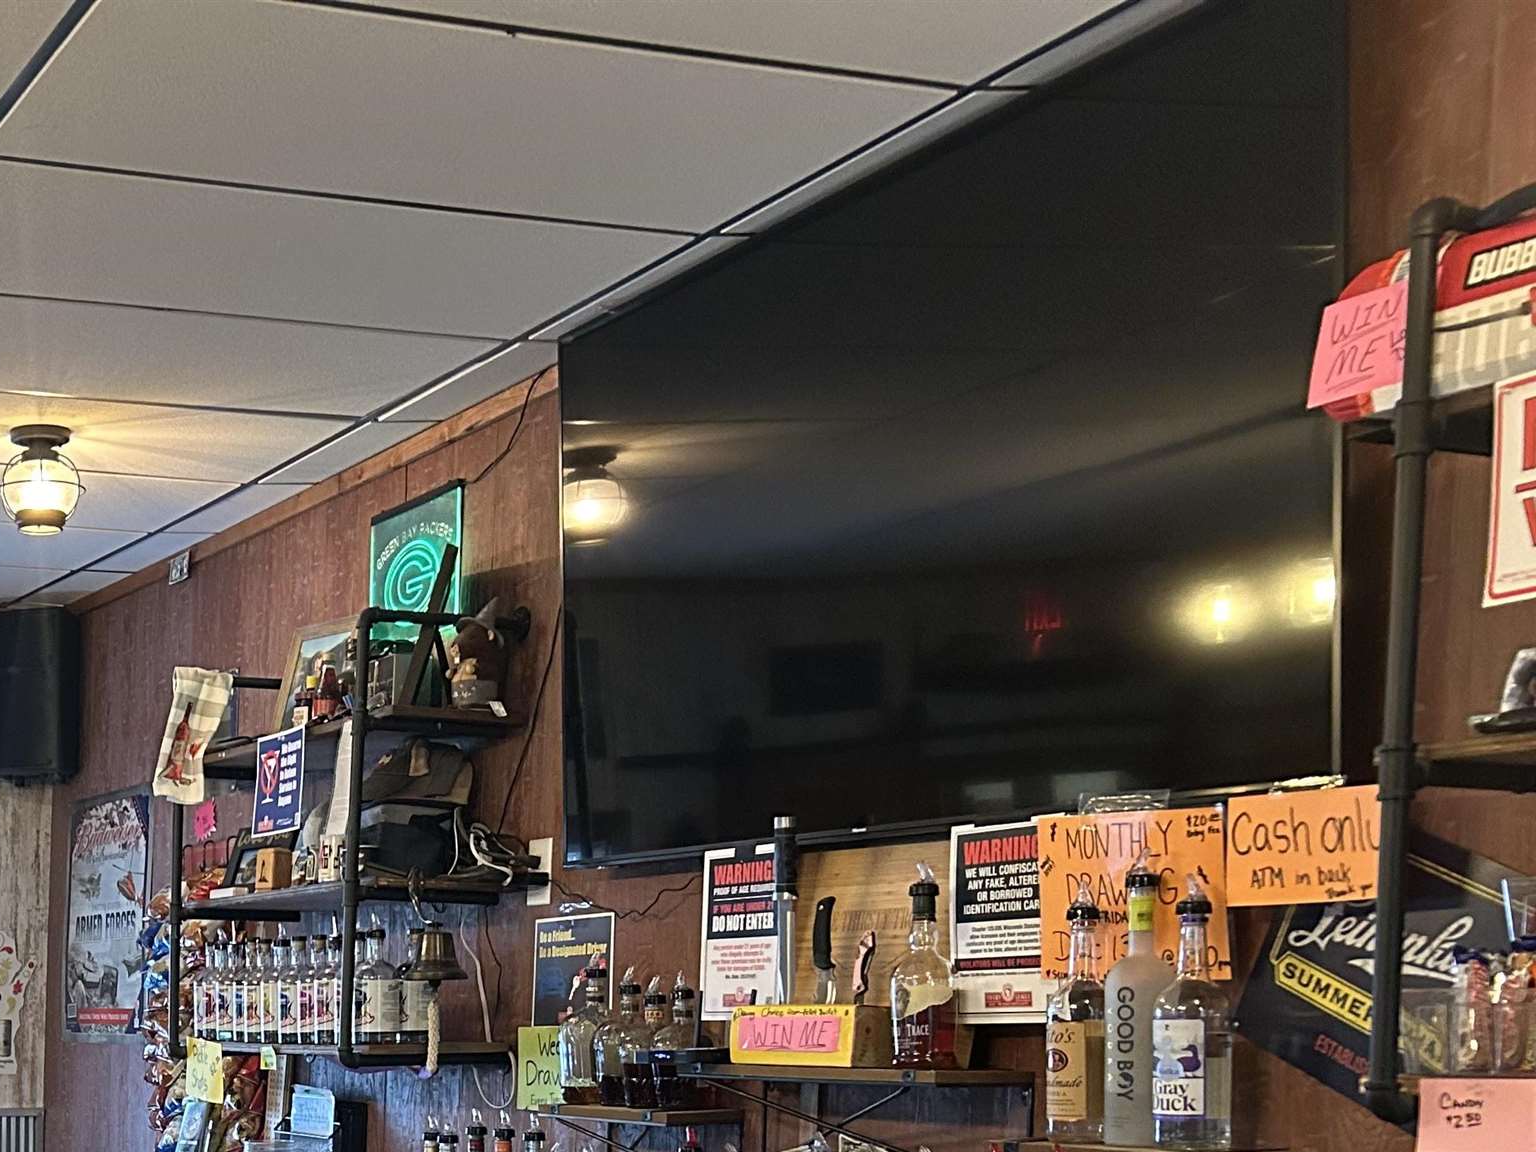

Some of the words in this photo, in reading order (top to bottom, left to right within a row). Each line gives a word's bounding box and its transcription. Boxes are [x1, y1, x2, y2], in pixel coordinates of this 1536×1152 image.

[75, 820, 145, 852] Budweiser
[1066, 820, 1174, 860] MONTHLY
[1231, 805, 1313, 857] Cash
[965, 868, 978, 879] WE
[978, 866, 997, 878] WILL
[967, 879, 984, 891] ANY
[984, 877, 1007, 890] FAKE,
[1250, 865, 1285, 890] ATM
[1295, 872, 1311, 886] in
[1316, 862, 1352, 886] back
[713, 885, 730, 896] PROOF
[739, 885, 750, 894] AGE
[976, 892, 988, 902] OR
[990, 887, 1034, 900] BORROWED
[712, 915, 725, 933] DO
[725, 913, 744, 931] NOT
[745, 911, 775, 931] ENTER
[963, 900, 1022, 916] IDENTIFICATION
[75, 914, 103, 939] ARMED
[105, 909, 137, 938] FORCES
[1281, 962, 1375, 1022] SUMME
[752, 1019, 795, 1047] WIN
[800, 1020, 833, 1048] ME
[1117, 986, 1135, 1054] GOOD
